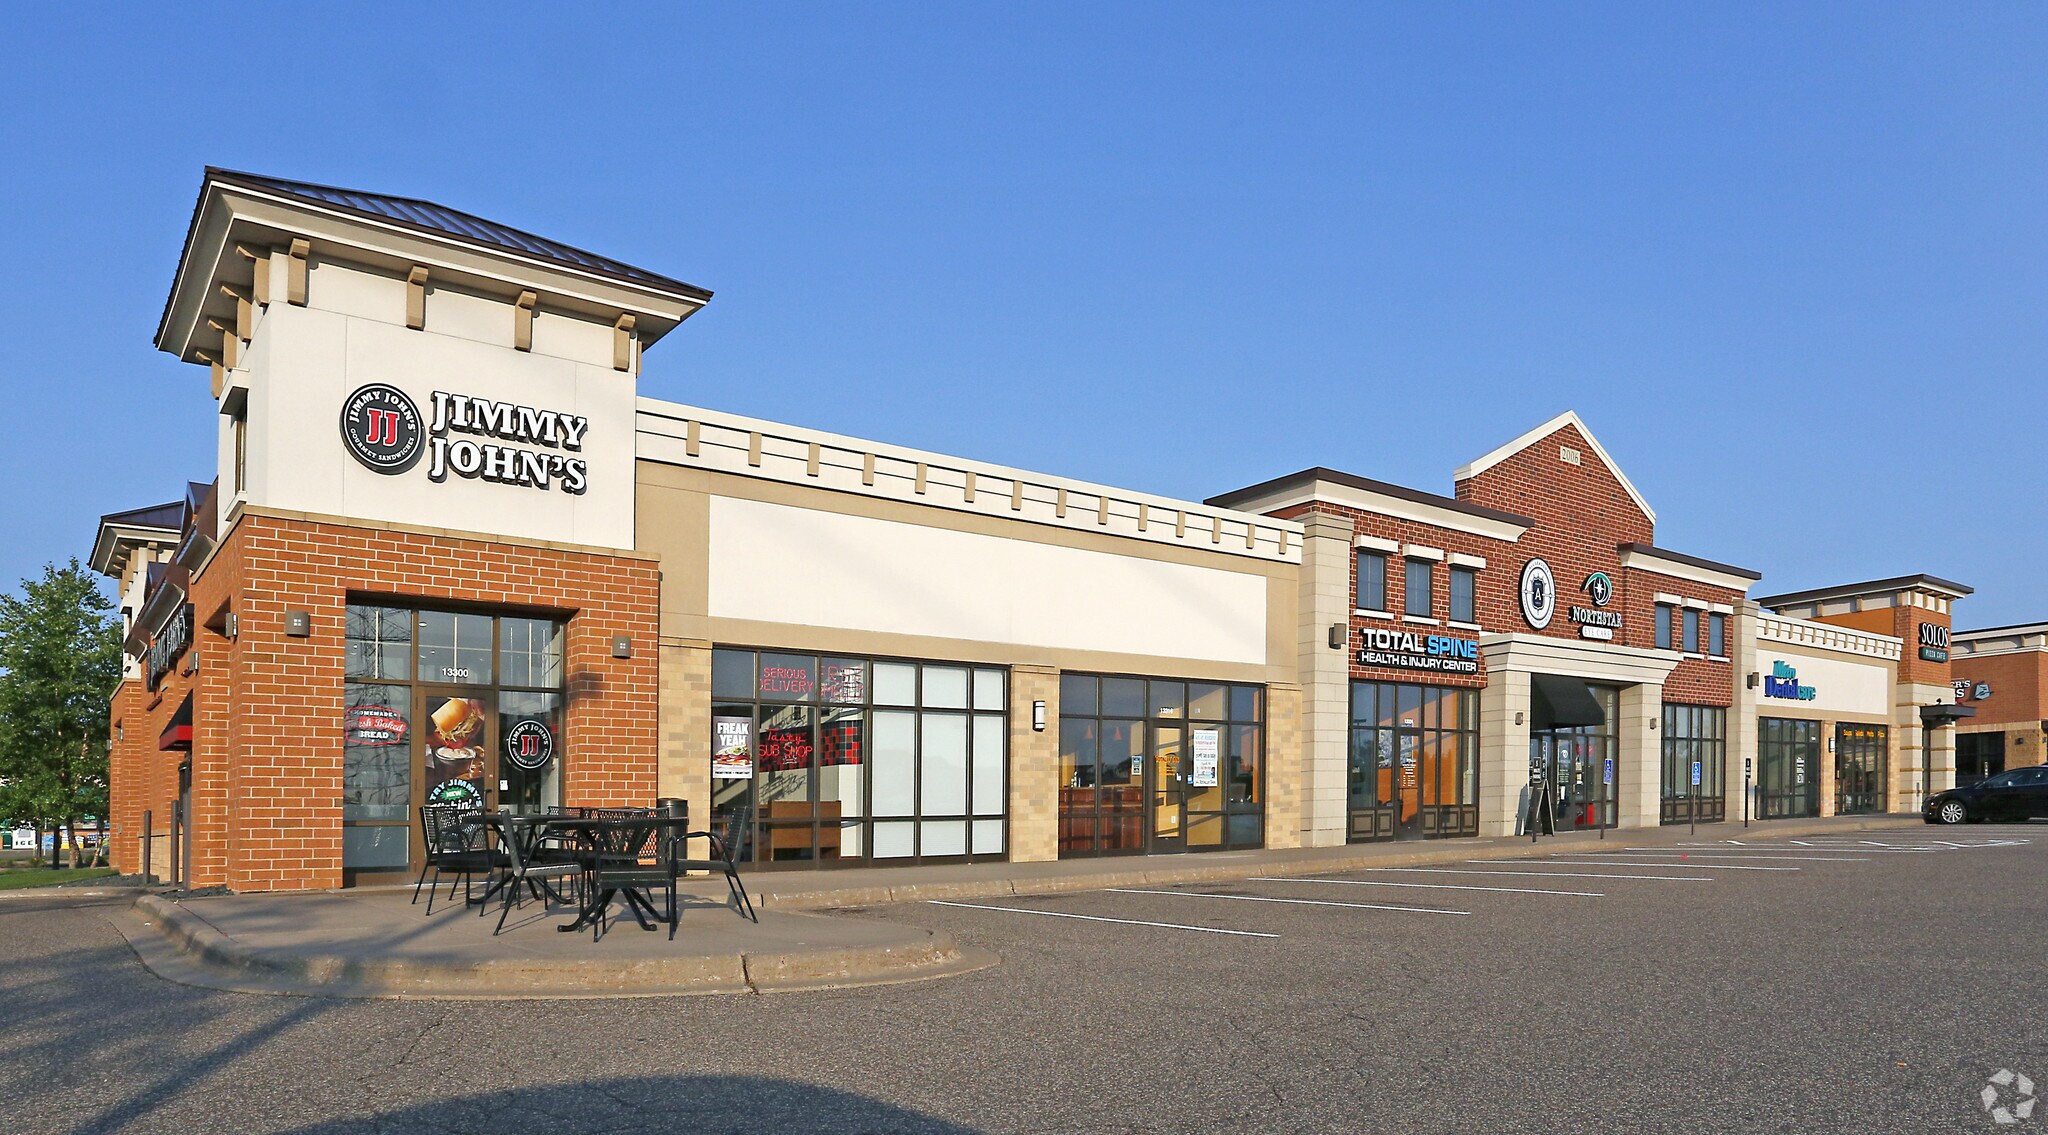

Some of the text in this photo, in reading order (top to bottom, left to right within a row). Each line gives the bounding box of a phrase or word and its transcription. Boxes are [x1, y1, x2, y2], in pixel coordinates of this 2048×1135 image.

[349, 391, 416, 431] JIMMY JOHN'S
[430, 390, 588, 447] JIMMY
[366, 407, 401, 447] JJ
[350, 428, 415, 461] GOURMET SANDWICHES
[430, 436, 587, 492] JOHN'S
[1562, 448, 1579, 463] 2006
[1534, 587, 1542, 601] A
[1572, 605, 1623, 628] NORTHSTAR
[1584, 626, 1611, 639] EYE CARE
[1921, 622, 1949, 648] SOLOS
[1362, 628, 1479, 659] TOTAL SPINE
[1361, 651, 1477, 672] HEALTH & INJURY CENTER
[441, 667, 469, 678] 13300
[763, 667, 807, 680] SERIOUS
[759, 679, 814, 693] DELIVERY
[373, 718, 404, 731] Baked
[717, 722, 749, 734] FREAK
[511, 724, 549, 745] JIMMY JOHN'S
[720, 735, 747, 747] YEAH
[766, 728, 806, 745] Tasty
[520, 734, 540, 756] JJ
[759, 744, 813, 758] SUB SHOP
[429, 779, 484, 808] TRY JIMMY'S
[446, 790, 462, 798] NEW
